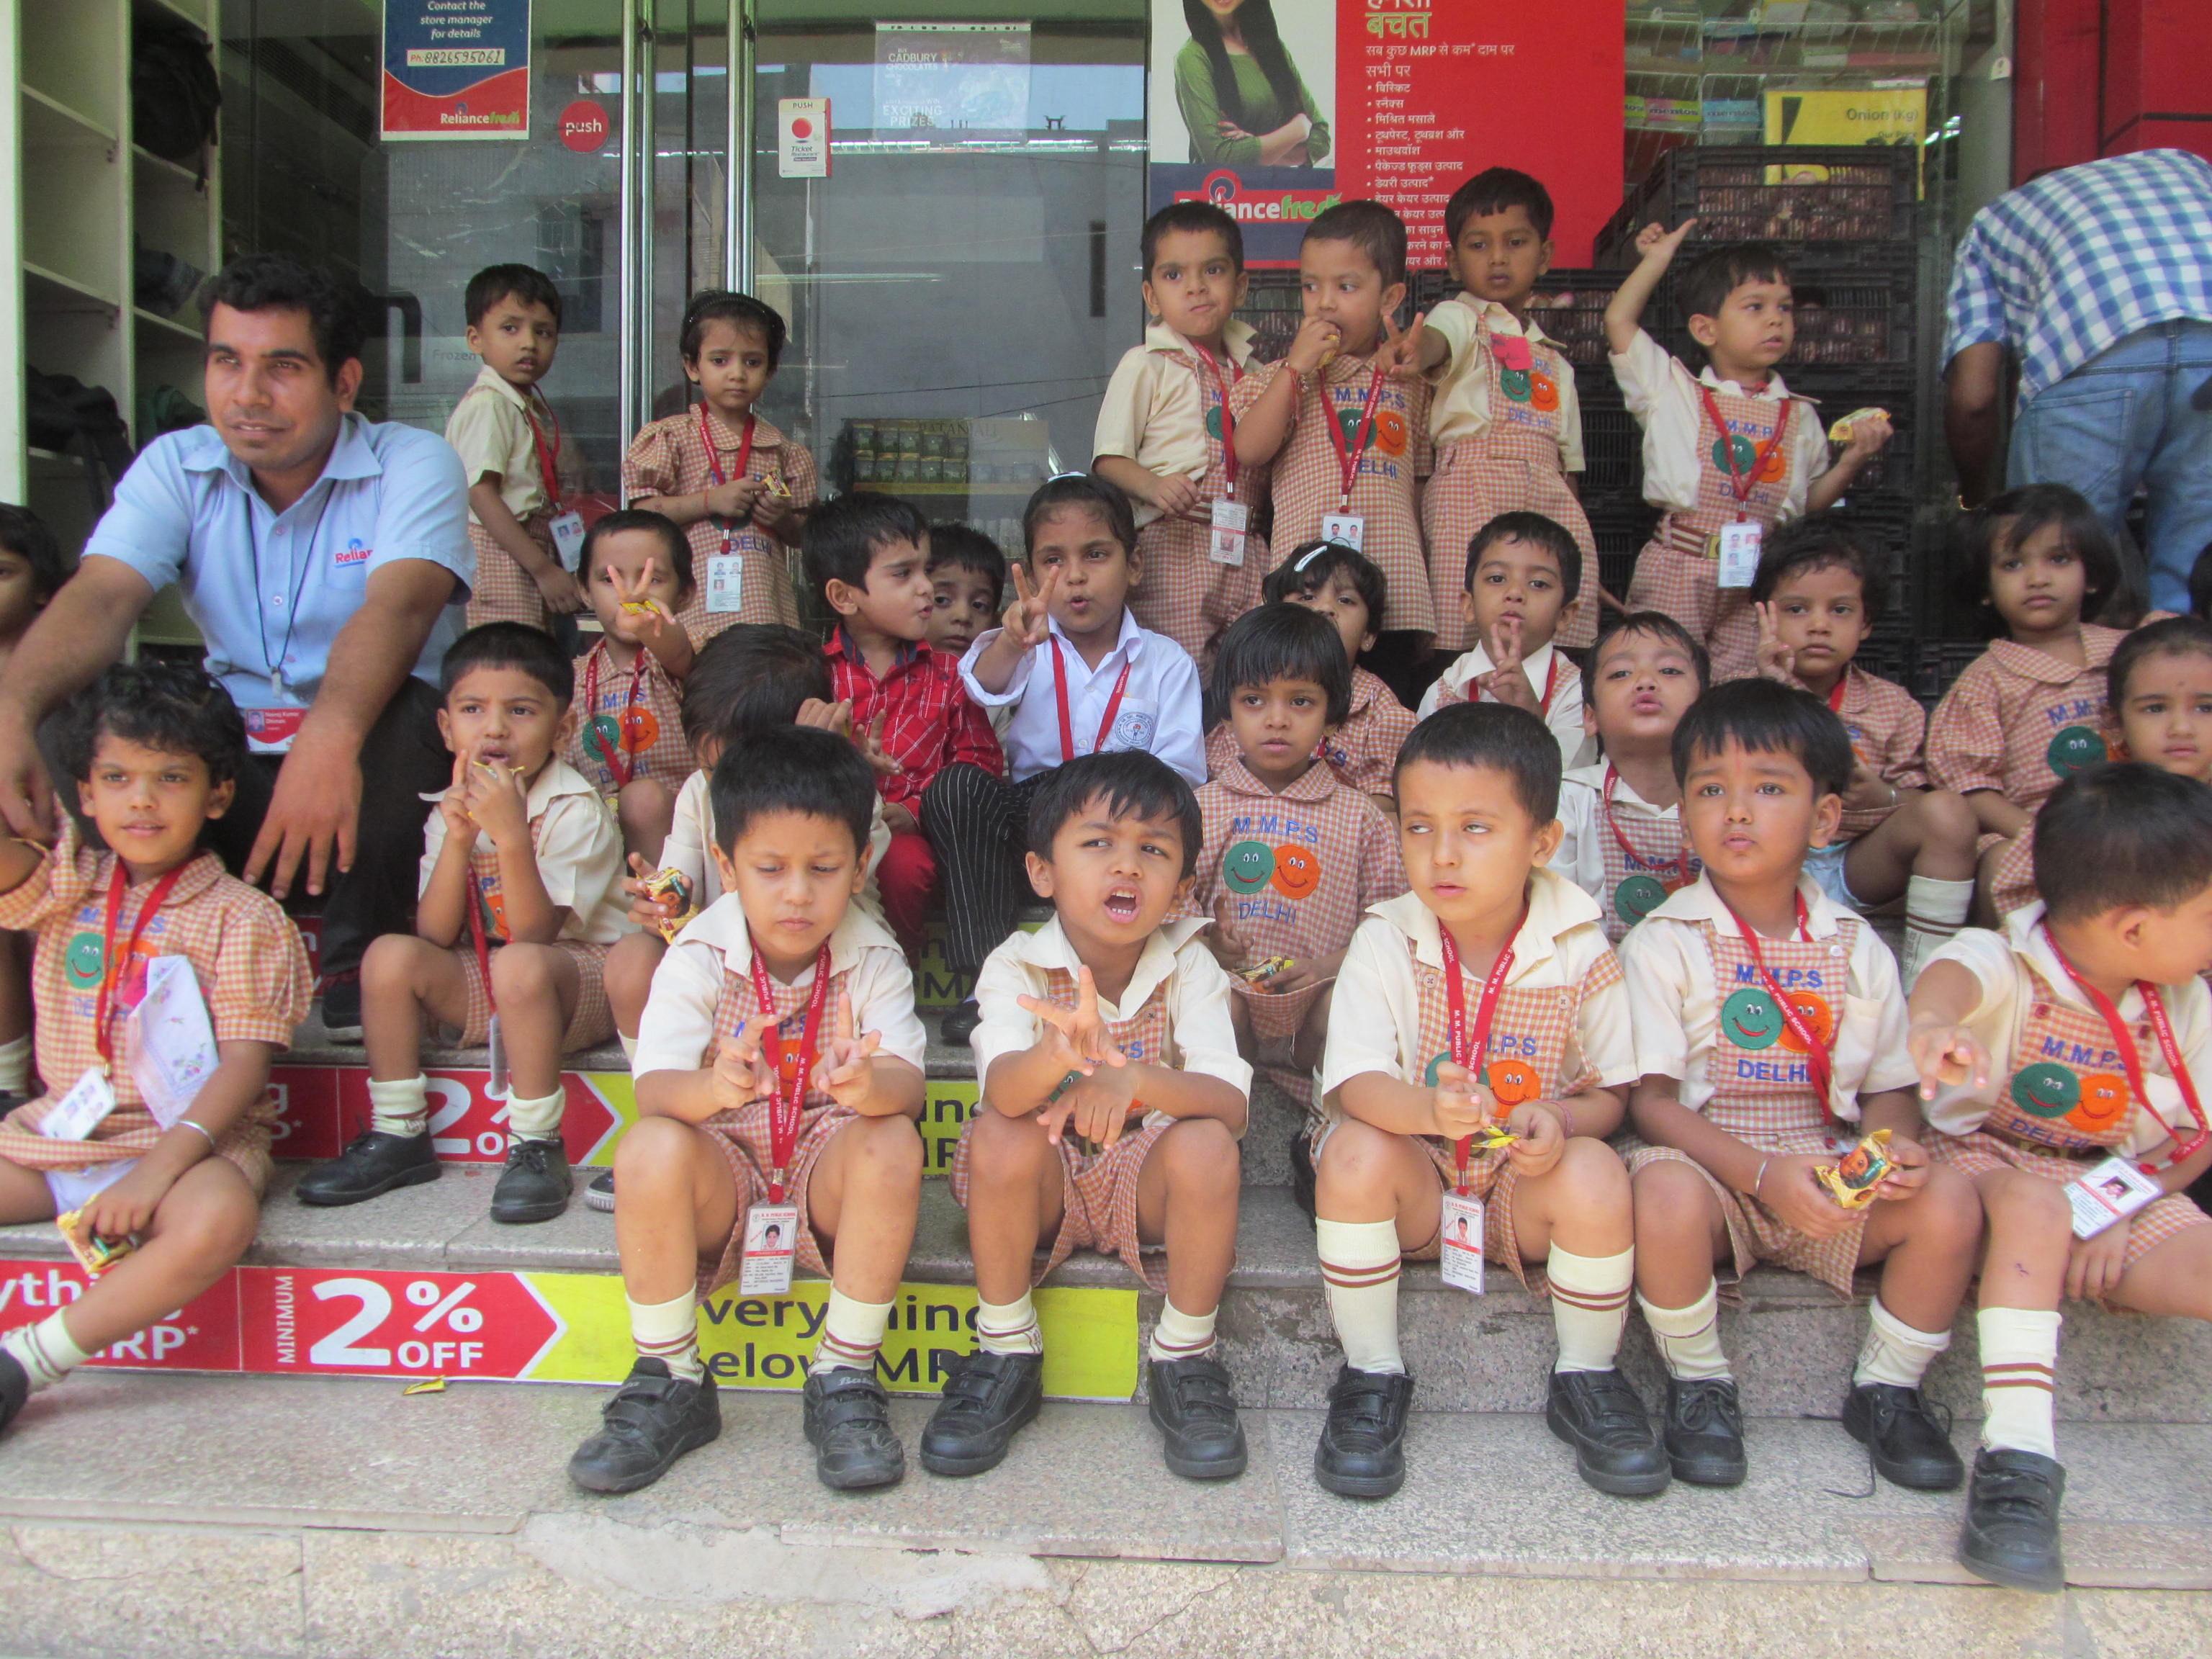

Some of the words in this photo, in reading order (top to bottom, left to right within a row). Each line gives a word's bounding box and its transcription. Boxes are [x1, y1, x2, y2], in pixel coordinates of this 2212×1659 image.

[427, 1, 467, 11] Contact
[469, 1, 486, 10] the
[420, 16, 446, 24] store
[447, 16, 493, 26] manager
[1365, 12, 1433, 39] बचत
[431, 28, 446, 40] for
[447, 28, 481, 38] details
[888, 53, 938, 63] CADBURY
[1366, 45, 1383, 55] सब
[1387, 45, 1408, 59] कुछ
[1410, 46, 1437, 56] MRP
[1478, 44, 1498, 55] दाम
[1365, 61, 1392, 77] सभी
[1395, 65, 1411, 77] पर
[883, 105, 943, 117] EXCITING
[889, 116, 935, 127] PRIZES
[1845, 108, 1890, 121] Onion
[1894, 109, 1919, 122] (Kg)
[565, 119, 603, 137] push
[1508, 407, 1552, 430] DELHI
[1346, 459, 1398, 480] ELHI
[1232, 815, 1318, 844] M.M.P.S
[1238, 900, 1297, 925] DELHI
[1496, 953, 1511, 976] PUBLIC
[760, 974, 771, 1000] PUBLIC
[811, 979, 824, 1009] SCHOOL
[1774, 992, 1794, 1018] PUBLIC
[1790, 1017, 1813, 1045] SCHOOL
[1454, 1030, 1462, 1058] PUBLIC
[1468, 1040, 1481, 1071] SCHOOL
[792, 1077, 804, 1107] PUBLIC
[775, 1097, 784, 1123] PUBLIC
[787, 1109, 799, 1136] SCHOOL
[275, 1275, 296, 1364] MINIMUM
[397, 1341, 485, 1369] OFF
